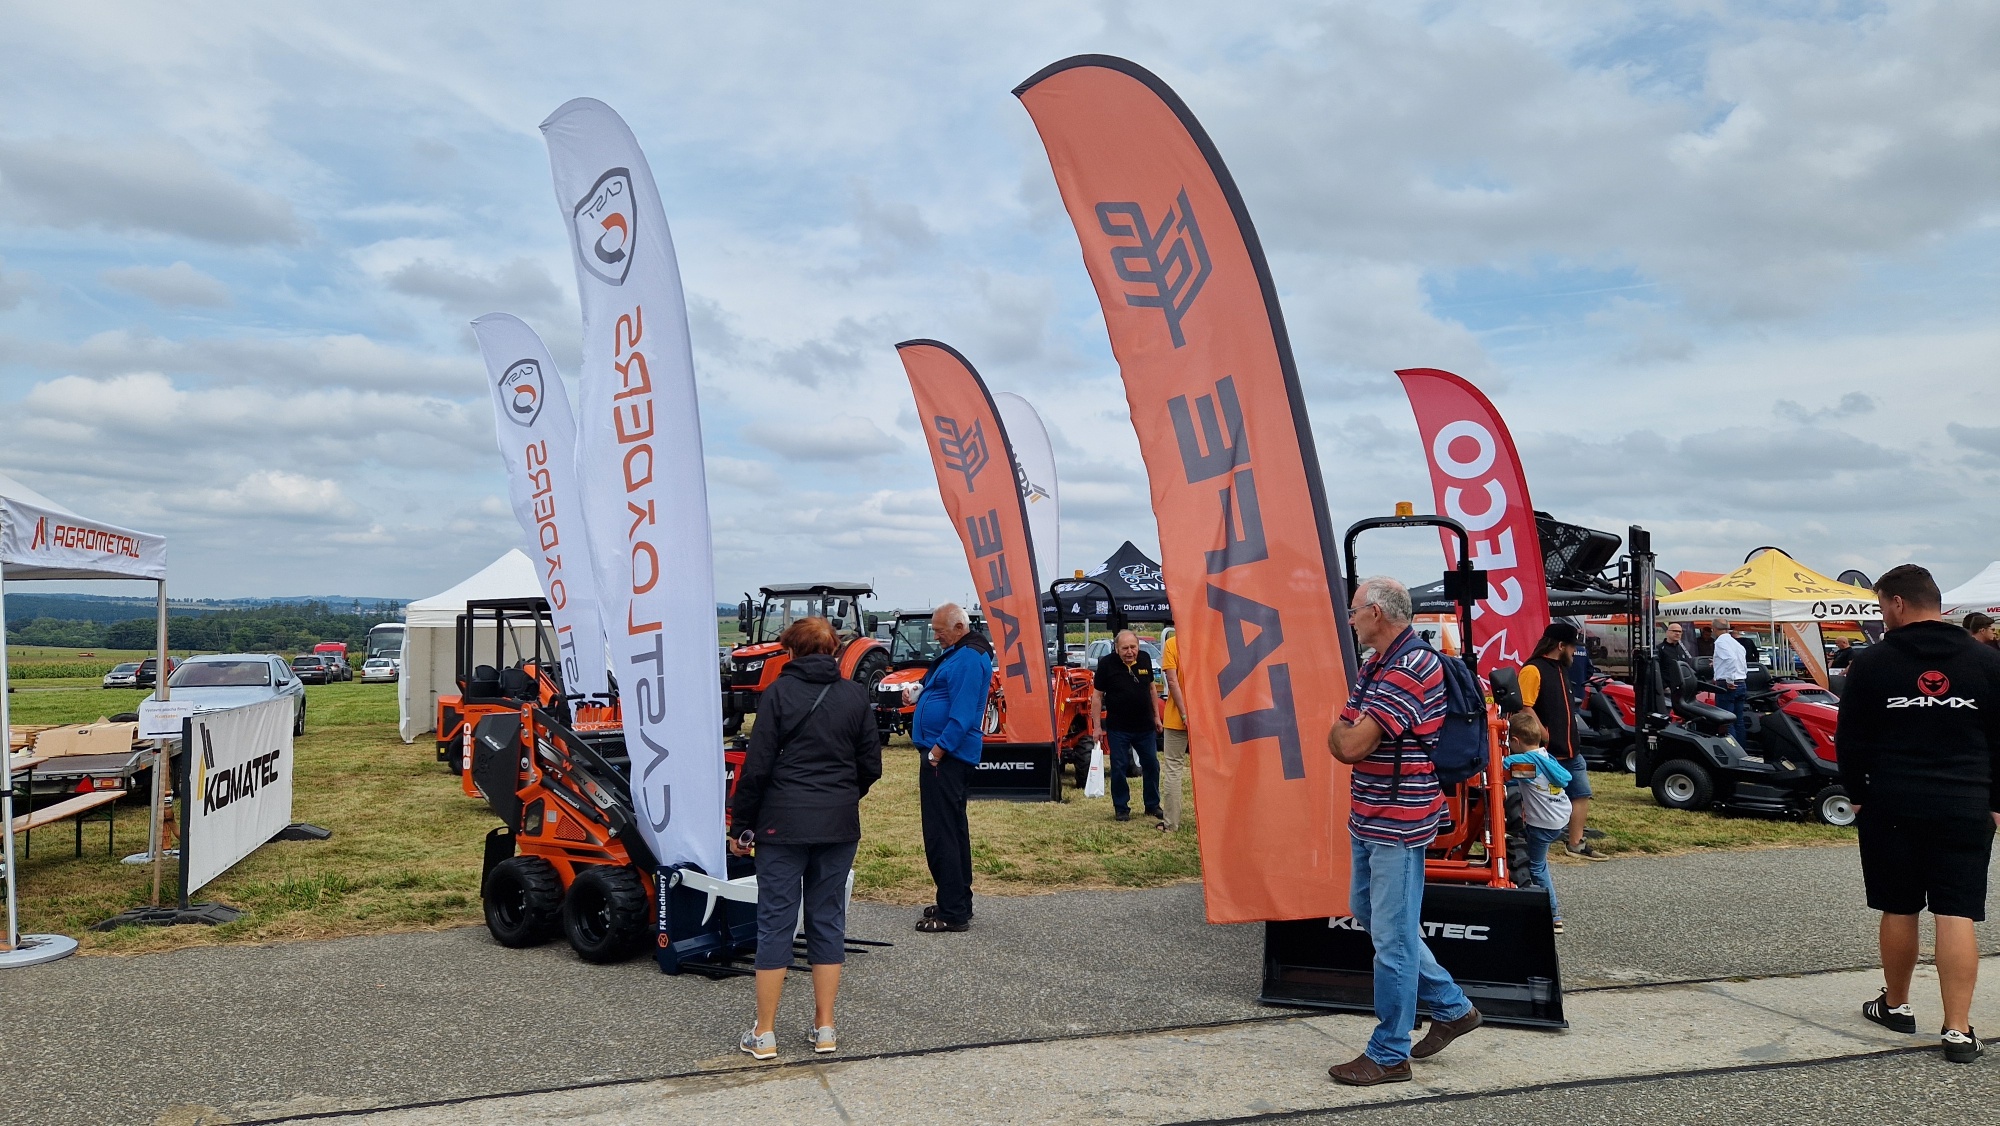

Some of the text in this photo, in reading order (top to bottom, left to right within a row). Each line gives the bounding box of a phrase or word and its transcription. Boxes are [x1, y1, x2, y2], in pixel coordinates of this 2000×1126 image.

[53, 525, 140, 558] AGROMETALL
[1664, 605, 1742, 617] www.dakr.com
[1887, 696, 1979, 710] 24MX
[203, 749, 280, 817] KOMATEC
[659, 874, 667, 931] FK Machinery
[1328, 916, 1491, 941] KTEC
